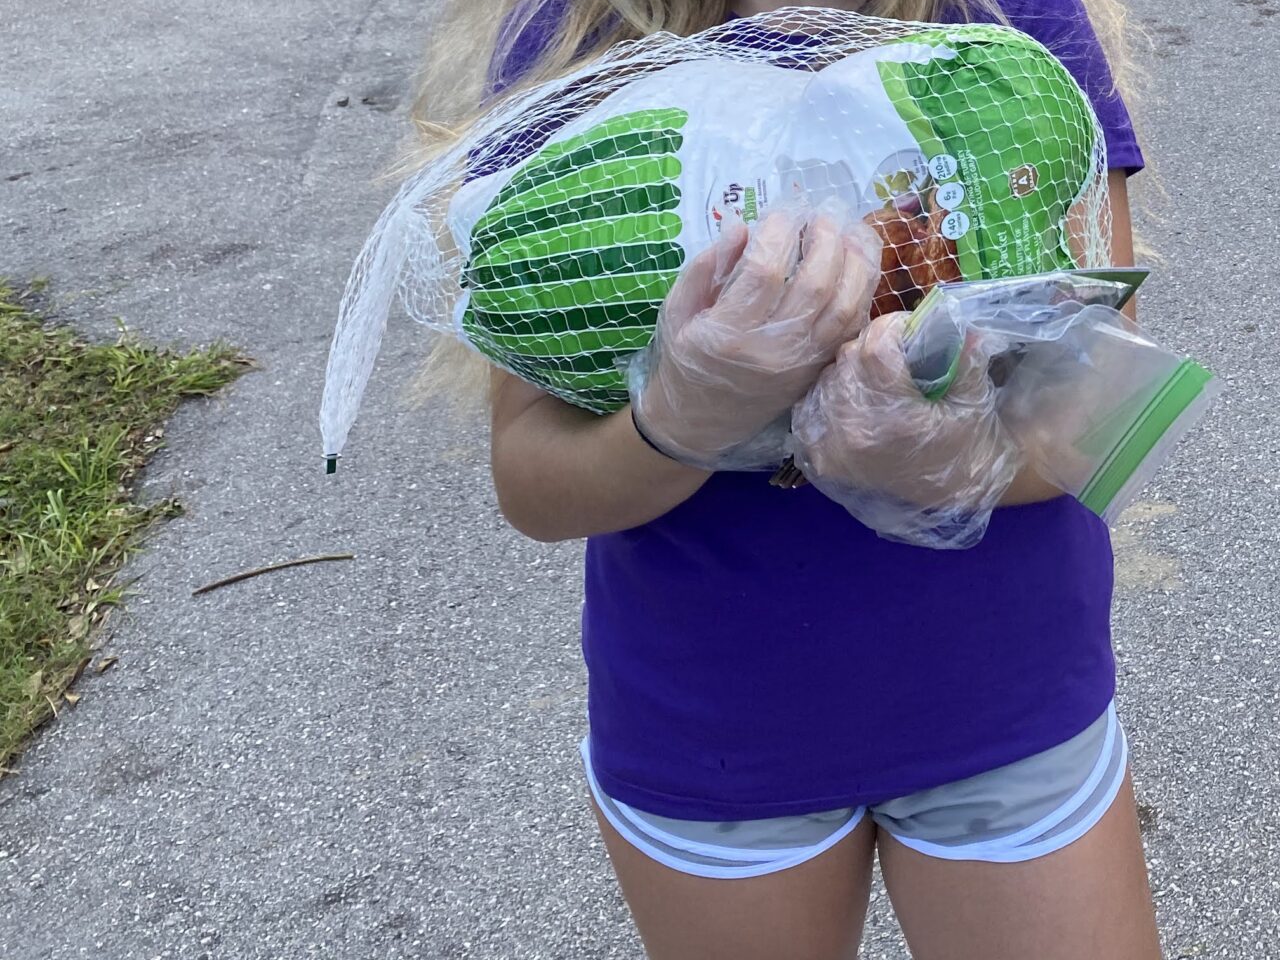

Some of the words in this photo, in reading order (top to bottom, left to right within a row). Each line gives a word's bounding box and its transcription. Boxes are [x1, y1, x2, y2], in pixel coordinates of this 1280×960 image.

[1018, 175, 1027, 185] A
[723, 183, 744, 205] Up
[948, 218, 957, 236] 140
